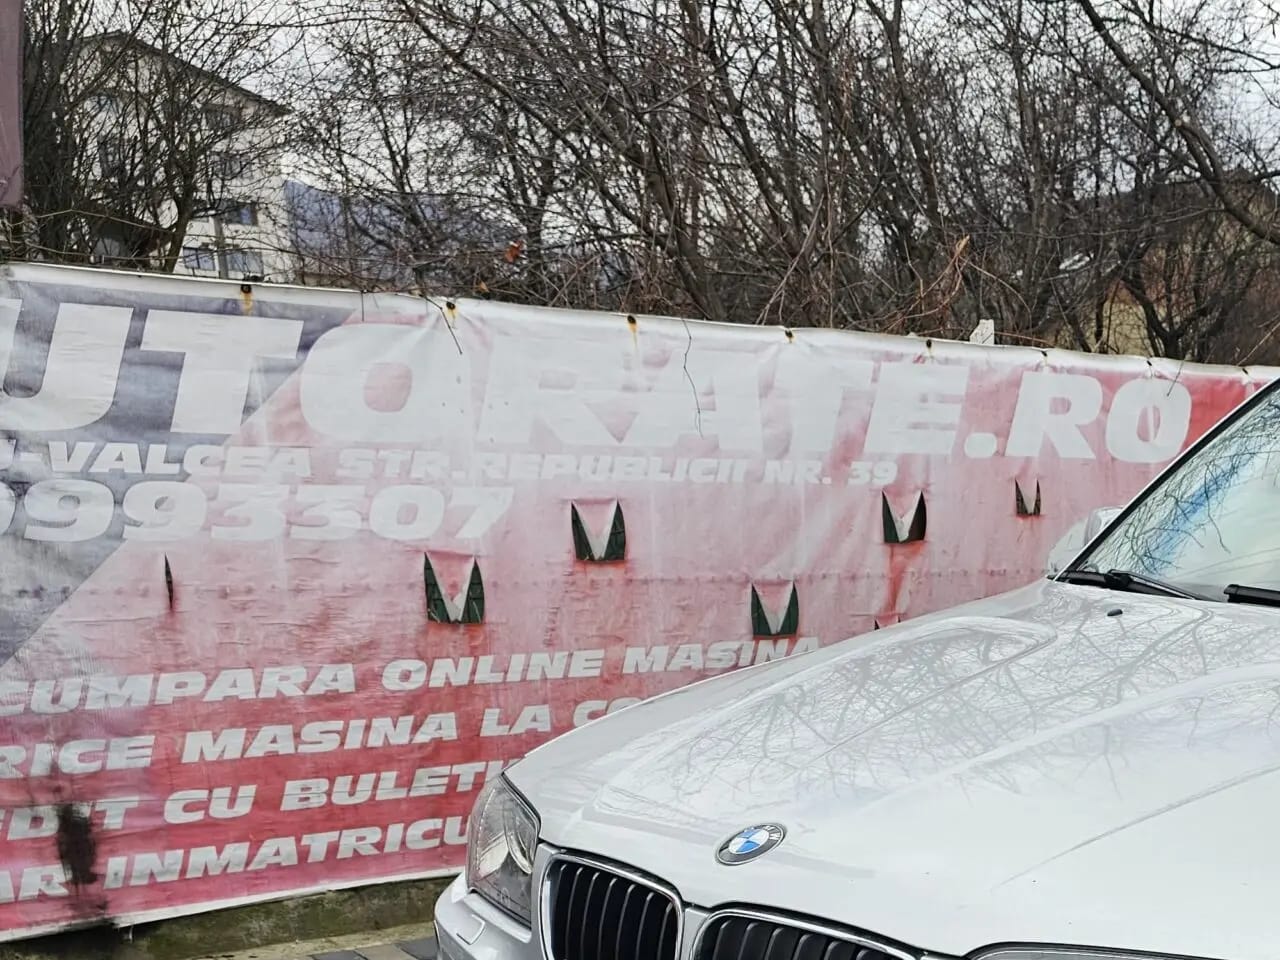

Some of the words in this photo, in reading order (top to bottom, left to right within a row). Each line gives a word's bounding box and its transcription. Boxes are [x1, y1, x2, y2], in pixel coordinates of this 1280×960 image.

[763, 460, 832, 485] NR.
[847, 460, 898, 485] 39
[0, 479, 514, 542] 993307
[0, 663, 357, 717] CUMPARA
[381, 648, 606, 691] ONLINE
[181, 712, 459, 764] MASINA
[479, 704, 551, 737] LA
[163, 784, 257, 825] CU
